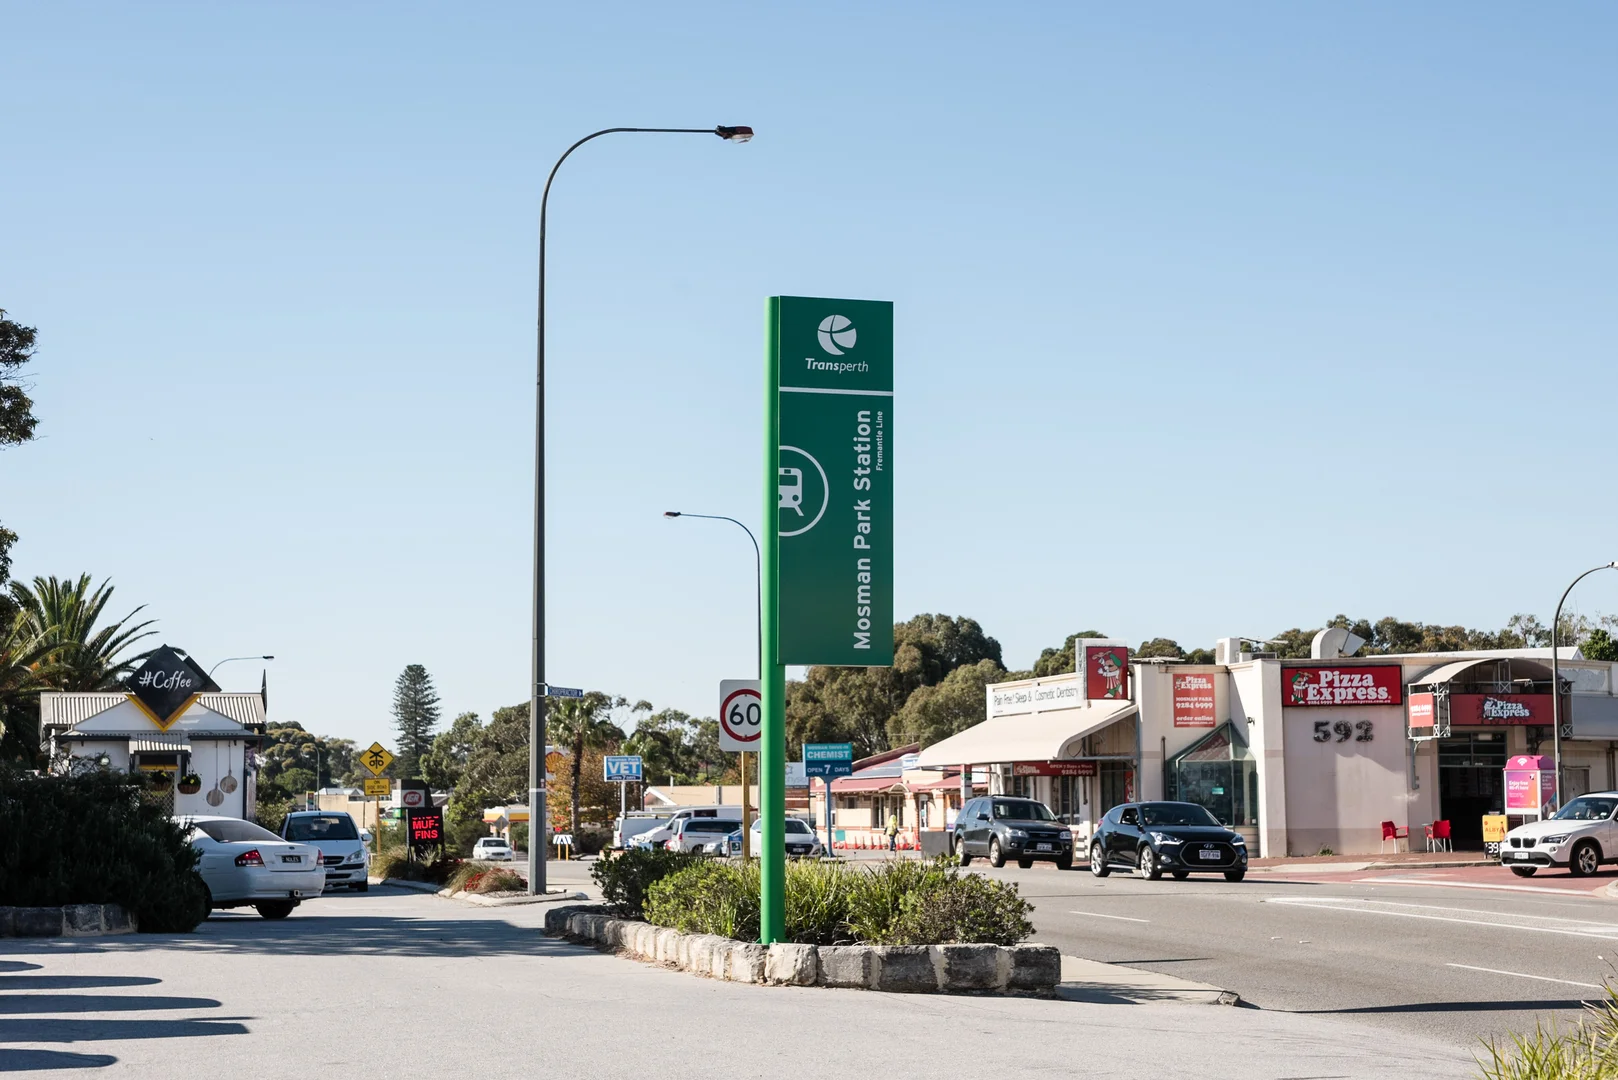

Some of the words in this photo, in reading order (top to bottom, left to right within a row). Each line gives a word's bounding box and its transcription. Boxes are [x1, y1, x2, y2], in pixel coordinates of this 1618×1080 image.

[805, 358, 868, 374] Transperth
[875, 411, 883, 428] Line
[853, 410, 871, 491] Station
[875, 430, 883, 471] Fremantle
[853, 499, 871, 549] Park
[853, 558, 871, 649] Mosman
[138, 670, 192, 691] #Coffee
[1180, 682, 1212, 690] Express
[1185, 676, 1207, 684] Pizza
[1319, 671, 1374, 687] Pizza
[1028, 690, 1032, 702] &
[1035, 690, 1055, 701] Cosmetic
[1056, 687, 1079, 699] Dentistry
[1306, 683, 1388, 704] Express
[1491, 708, 1530, 718] Express
[1497, 701, 1523, 710] Pizza
[729, 703, 761, 726] 60
[1313, 720, 1374, 743] 592
[806, 750, 850, 759] CHEMIST
[607, 761, 640, 774] VET
[824, 764, 831, 775] 7
[412, 820, 439, 830] MUF-
[415, 830, 439, 840] FINS
